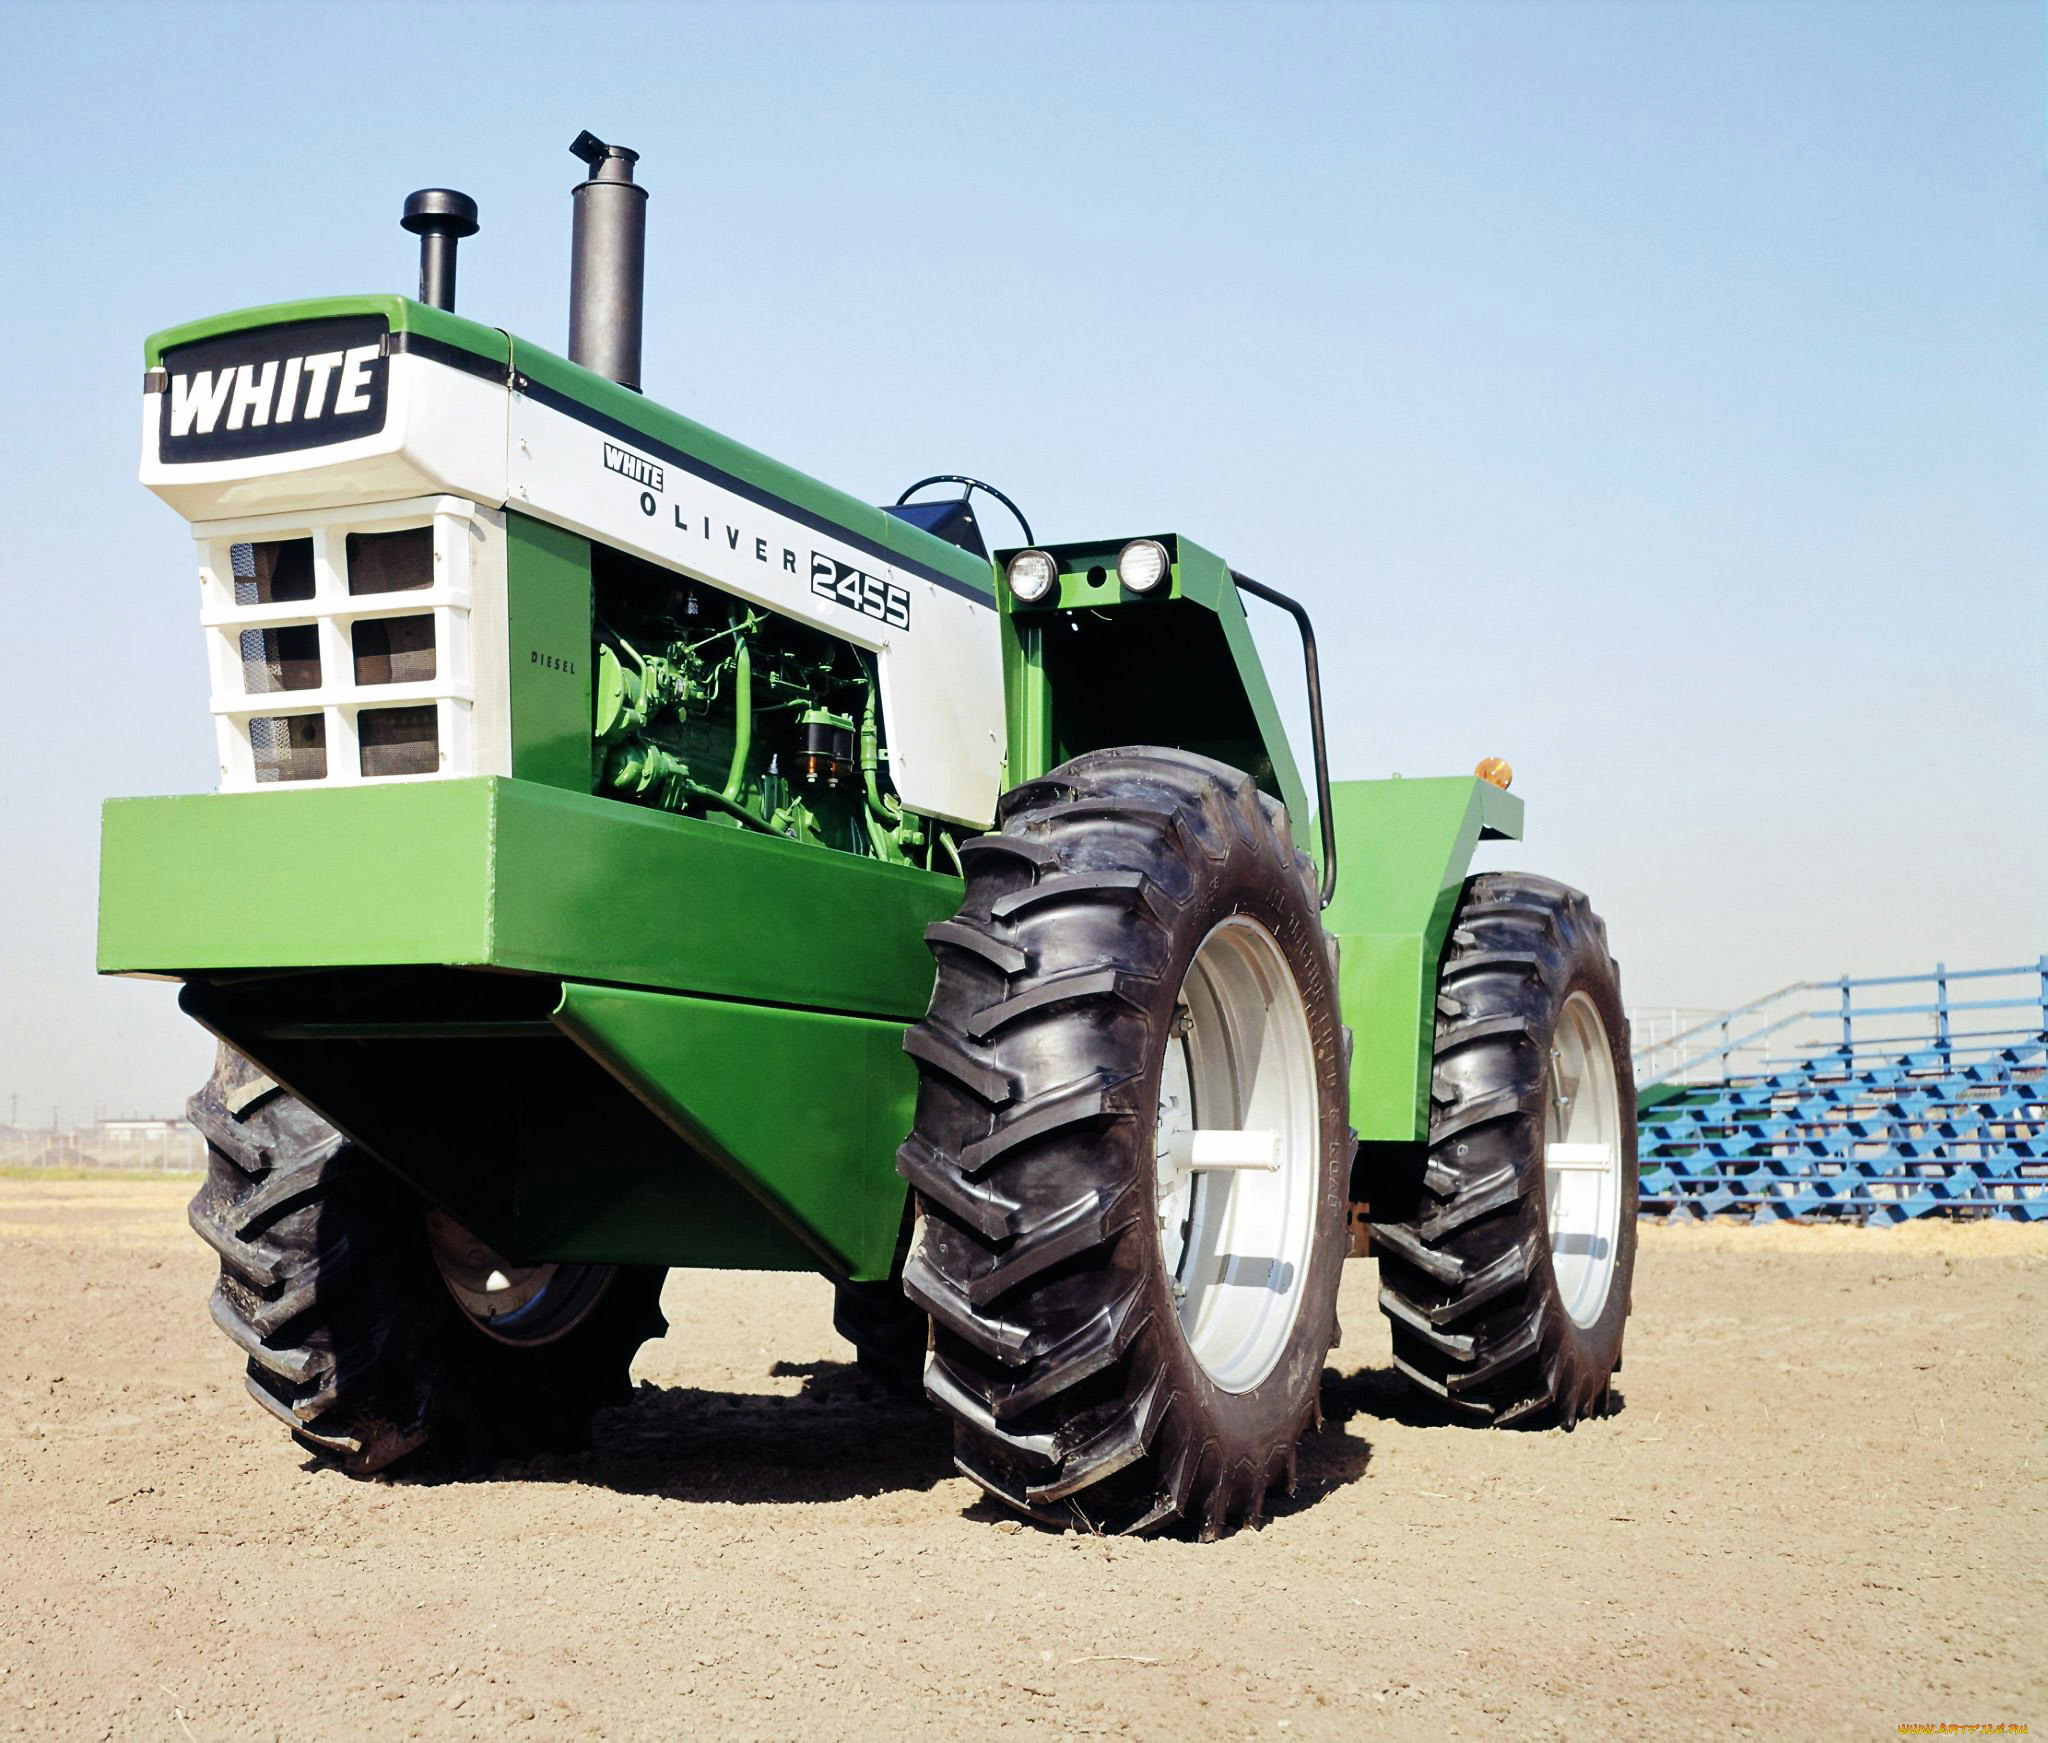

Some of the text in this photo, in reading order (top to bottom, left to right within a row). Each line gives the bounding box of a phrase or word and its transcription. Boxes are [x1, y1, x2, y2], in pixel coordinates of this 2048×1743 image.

[170, 343, 381, 437] WHITE
[605, 443, 663, 490] WHITE
[639, 491, 910, 630] OLIVER 2455
[531, 651, 575, 675] DIESEL
